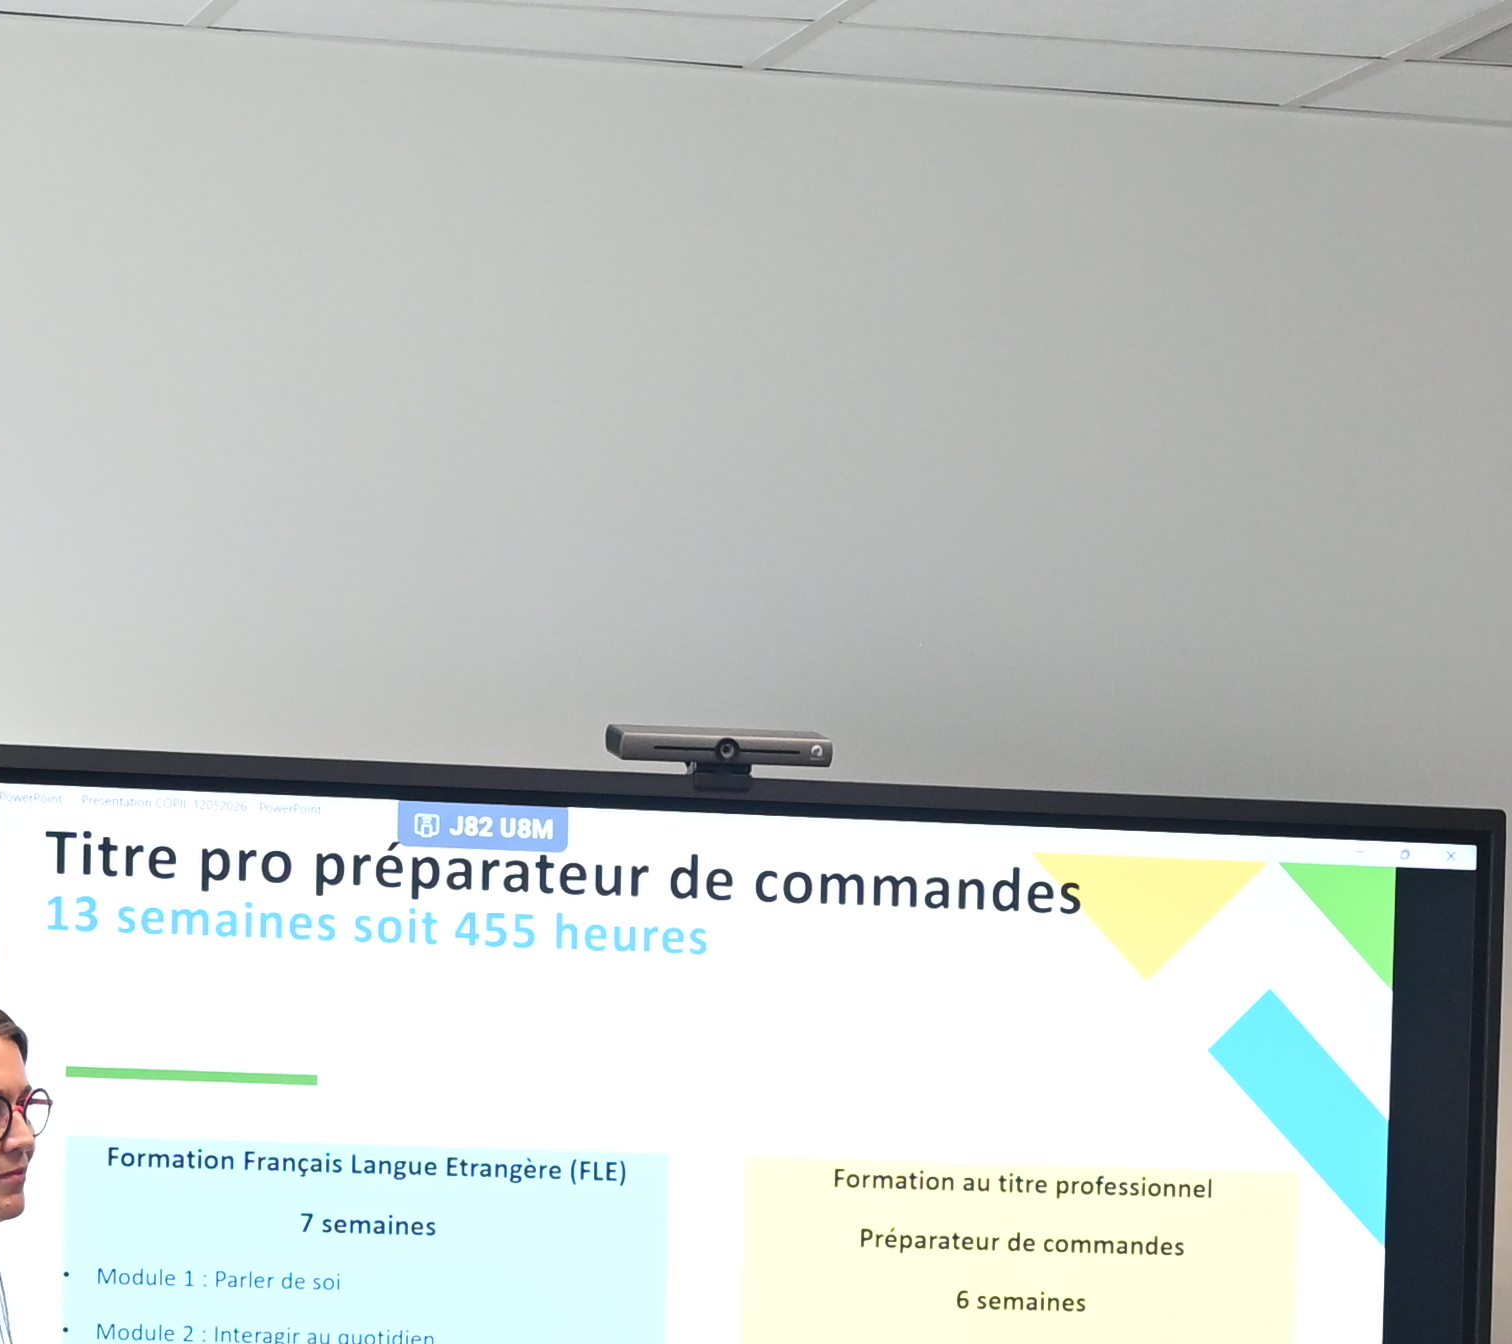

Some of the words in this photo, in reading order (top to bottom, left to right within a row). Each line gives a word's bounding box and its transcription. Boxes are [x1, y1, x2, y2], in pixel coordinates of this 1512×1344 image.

[155, 796, 188, 809] COPIL
[259, 800, 322, 815] PowerPoint
[448, 814, 495, 838] J82
[499, 816, 556, 841] U8M
[45, 830, 177, 880] Titre
[201, 847, 292, 893] pro
[315, 841, 650, 901] préparateur
[670, 853, 734, 901] de
[754, 863, 1085, 917] commandes
[47, 895, 99, 933] 13
[117, 901, 336, 942] semaines
[354, 907, 438, 945] soit
[454, 911, 536, 949] 455
[555, 912, 707, 955] heures
[107, 1146, 235, 1171] Formation
[244, 1150, 343, 1178] Français
[351, 1153, 438, 1181] Langue
[446, 1156, 562, 1184] Etrangère
[570, 1158, 626, 1187] (FLE)
[834, 1168, 954, 1192] Formation
[962, 1177, 990, 1193] au
[998, 1172, 1048, 1194] titre
[1056, 1175, 1213, 1200] professionnel
[300, 1212, 314, 1233] 7
[321, 1214, 437, 1237] semaines
[860, 1227, 1000, 1254] Préparateur
[1007, 1231, 1036, 1253] de
[1043, 1235, 1185, 1257] commandes
[97, 1267, 176, 1287] Module
[184, 1270, 195, 1287] 1
[215, 1270, 276, 1290] Parler
[281, 1270, 307, 1291] de
[312, 1272, 342, 1291] soi
[955, 1290, 970, 1310] 6
[976, 1291, 1086, 1313] semaines
[96, 1323, 175, 1342] Module
[183, 1325, 194, 1343] 2
